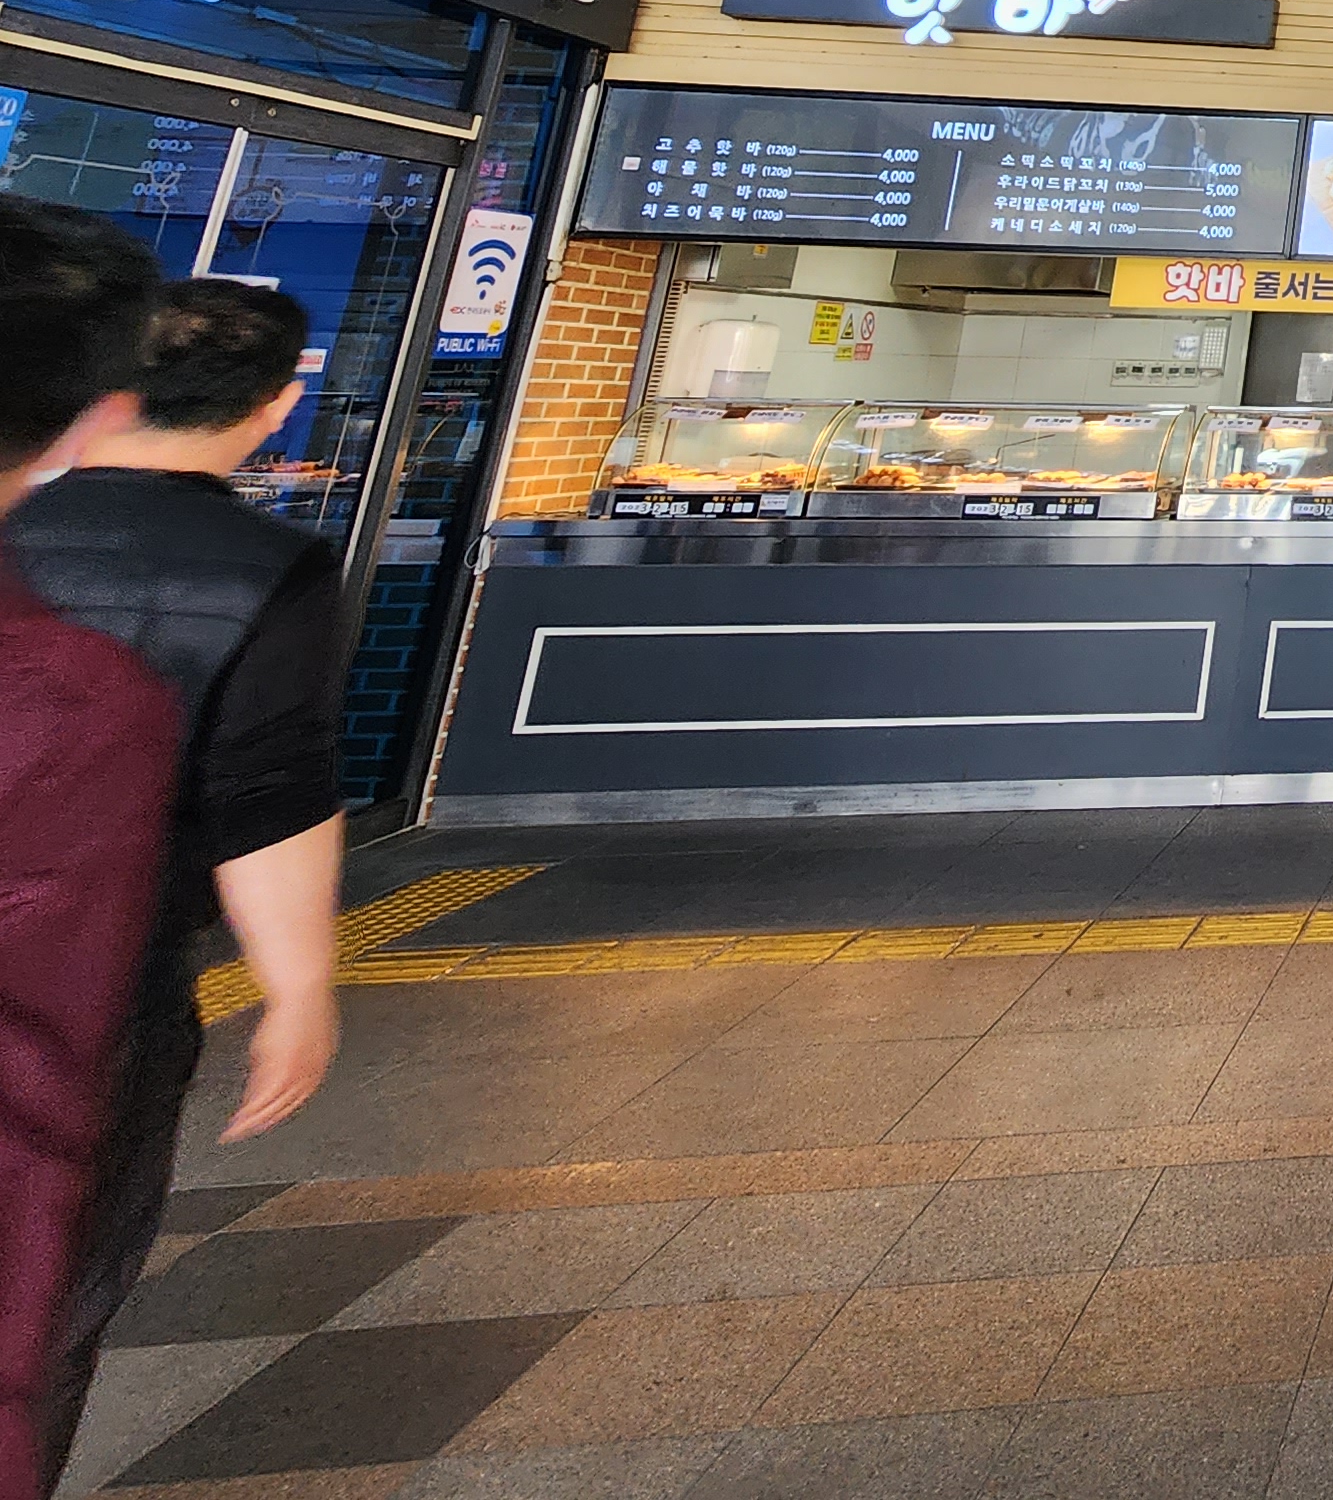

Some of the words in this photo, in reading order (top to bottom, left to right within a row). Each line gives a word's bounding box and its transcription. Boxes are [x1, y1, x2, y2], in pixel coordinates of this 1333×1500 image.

[931, 121, 996, 142] MENU
[882, 148, 919, 163] 4,000
[877, 169, 915, 184] 4,000
[1208, 162, 1242, 177] 4,000
[1205, 183, 1239, 198] 5,000
[873, 191, 911, 206] 4,000
[1202, 204, 1236, 219] 4,000
[869, 212, 907, 228] 4,000
[1199, 225, 1233, 240] 4,000
[1164, 260, 1245, 304] 핫바
[435, 337, 477, 353] PUBLIC
